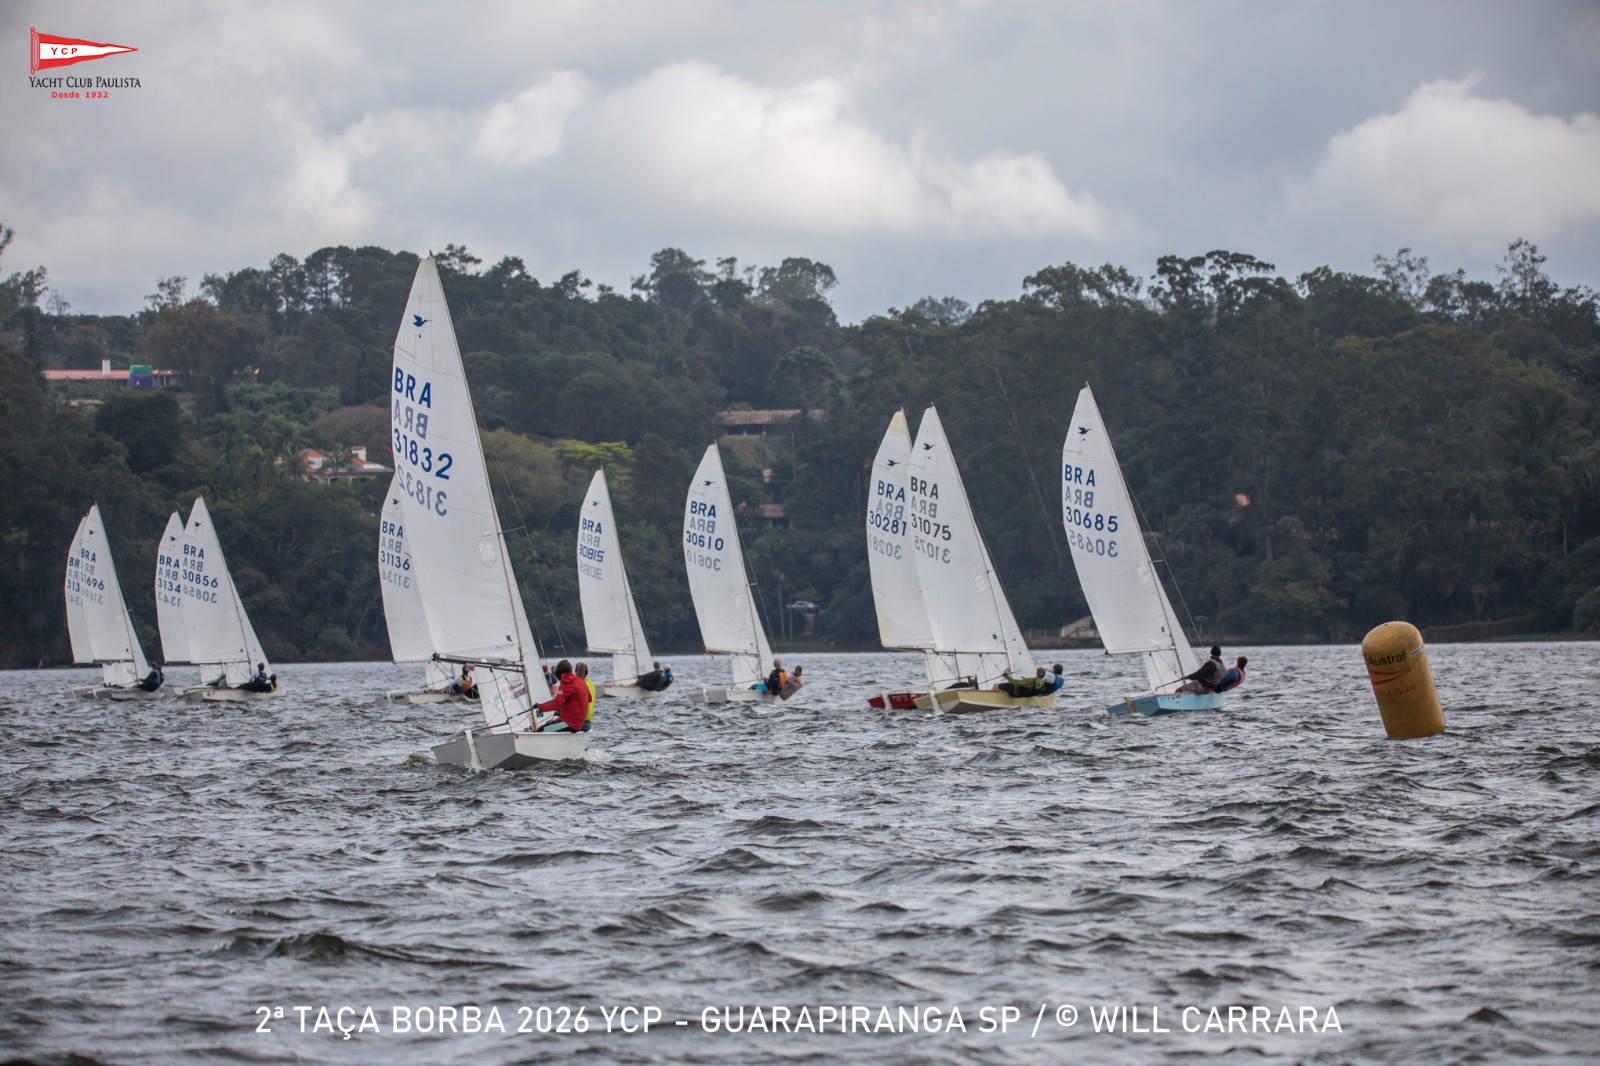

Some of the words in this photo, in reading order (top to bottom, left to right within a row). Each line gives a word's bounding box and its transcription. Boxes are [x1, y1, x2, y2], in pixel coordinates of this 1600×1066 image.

[394, 366, 431, 409] BRA
[394, 427, 453, 480] 31832
[1065, 463, 1095, 487] BRA
[877, 479, 905, 502] BRA
[911, 476, 938, 500] BRA
[690, 500, 716, 518] BRA
[382, 520, 403, 538] BRA
[582, 518, 602, 535] BRA
[869, 510, 907, 536] 30281
[911, 513, 952, 541] 31075
[1066, 506, 1118, 533] 30685
[686, 530, 724, 551] 30610
[81, 548, 96, 563] BRA
[183, 543, 204, 560] BRA
[380, 551, 410, 571] 31136
[578, 543, 605, 563] 30815
[69, 557, 80, 569] BR
[159, 555, 180, 570] BRA
[67, 579, 80, 593] 313
[157, 578, 181, 594] 3134
[182, 569, 218, 589] 30856
[1368, 651, 1406, 666] Austral
